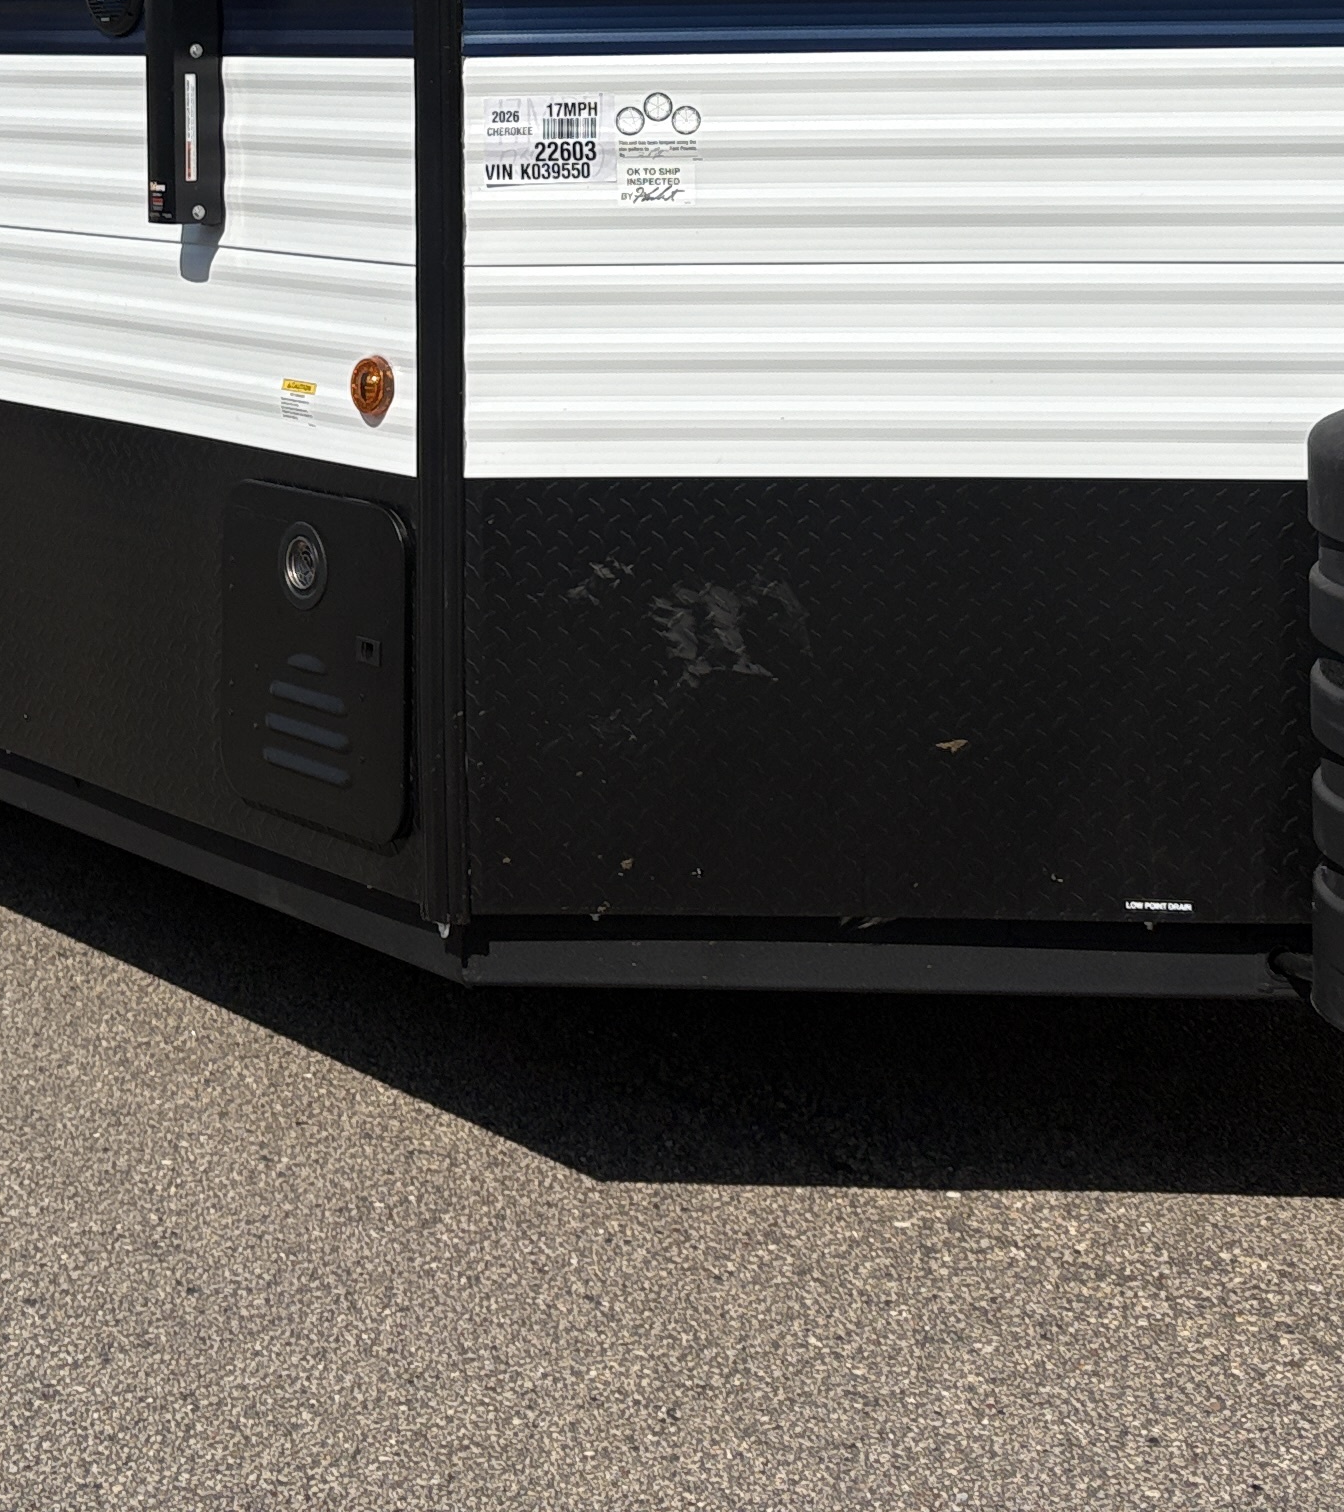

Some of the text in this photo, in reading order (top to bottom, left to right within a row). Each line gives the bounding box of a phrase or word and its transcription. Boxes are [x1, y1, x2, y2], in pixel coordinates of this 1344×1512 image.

[546, 101, 597, 117] 17MPH
[492, 111, 520, 123] 2026
[486, 126, 533, 136] CHEROKEE
[534, 140, 597, 162] 22603
[485, 162, 591, 180] VIN K039550
[626, 167, 681, 176] OK TO SHIP
[626, 177, 681, 186] INSPECTED
[621, 192, 633, 201] BY
[1125, 901, 1143, 909] LOW
